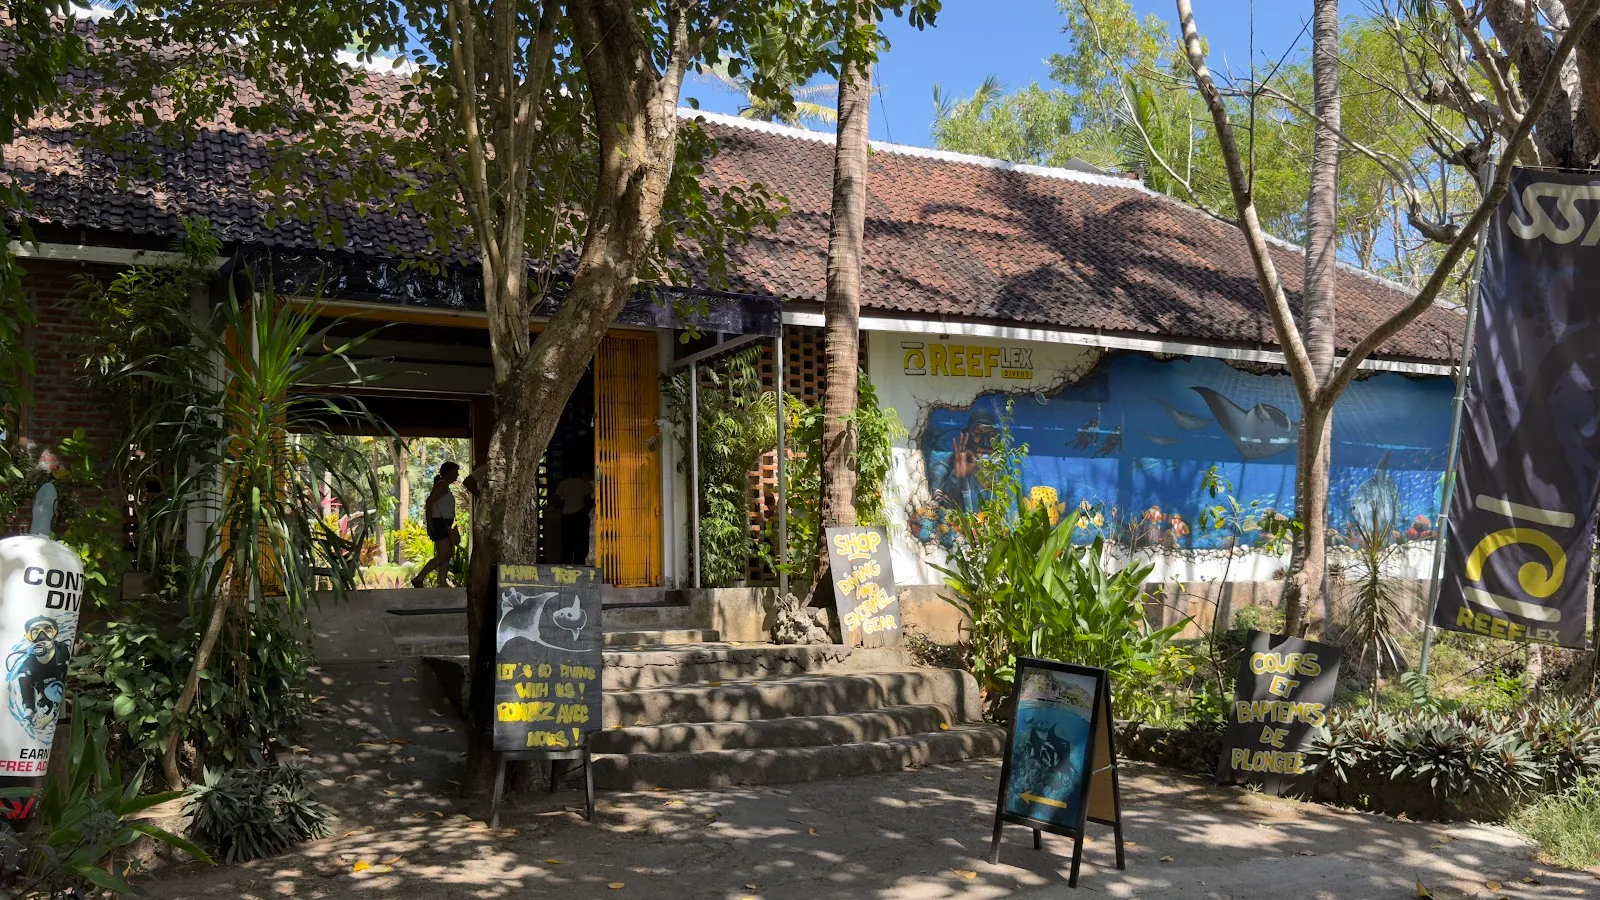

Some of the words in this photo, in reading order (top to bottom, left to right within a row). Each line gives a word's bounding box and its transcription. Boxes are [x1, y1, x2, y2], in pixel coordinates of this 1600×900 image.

[834, 532, 881, 556] SHOP
[551, 566, 582, 584] TRIP
[837, 560, 881, 597] DIVING
[46, 590, 81, 612] DIV
[862, 615, 898, 634] GEAR
[496, 663, 533, 680] LET'S
[538, 663, 552, 678] GO
[560, 661, 596, 681] DIVING
[1250, 652, 1321, 677] COURS
[515, 682, 548, 698] WITH
[1269, 676, 1300, 699] ET
[555, 704, 589, 724] AVEC
[1235, 700, 1326, 728] BAPTEMES
[526, 730, 569, 748] NOUS
[1259, 726, 1290, 748] DE
[19, 748, 50, 760] EARN
